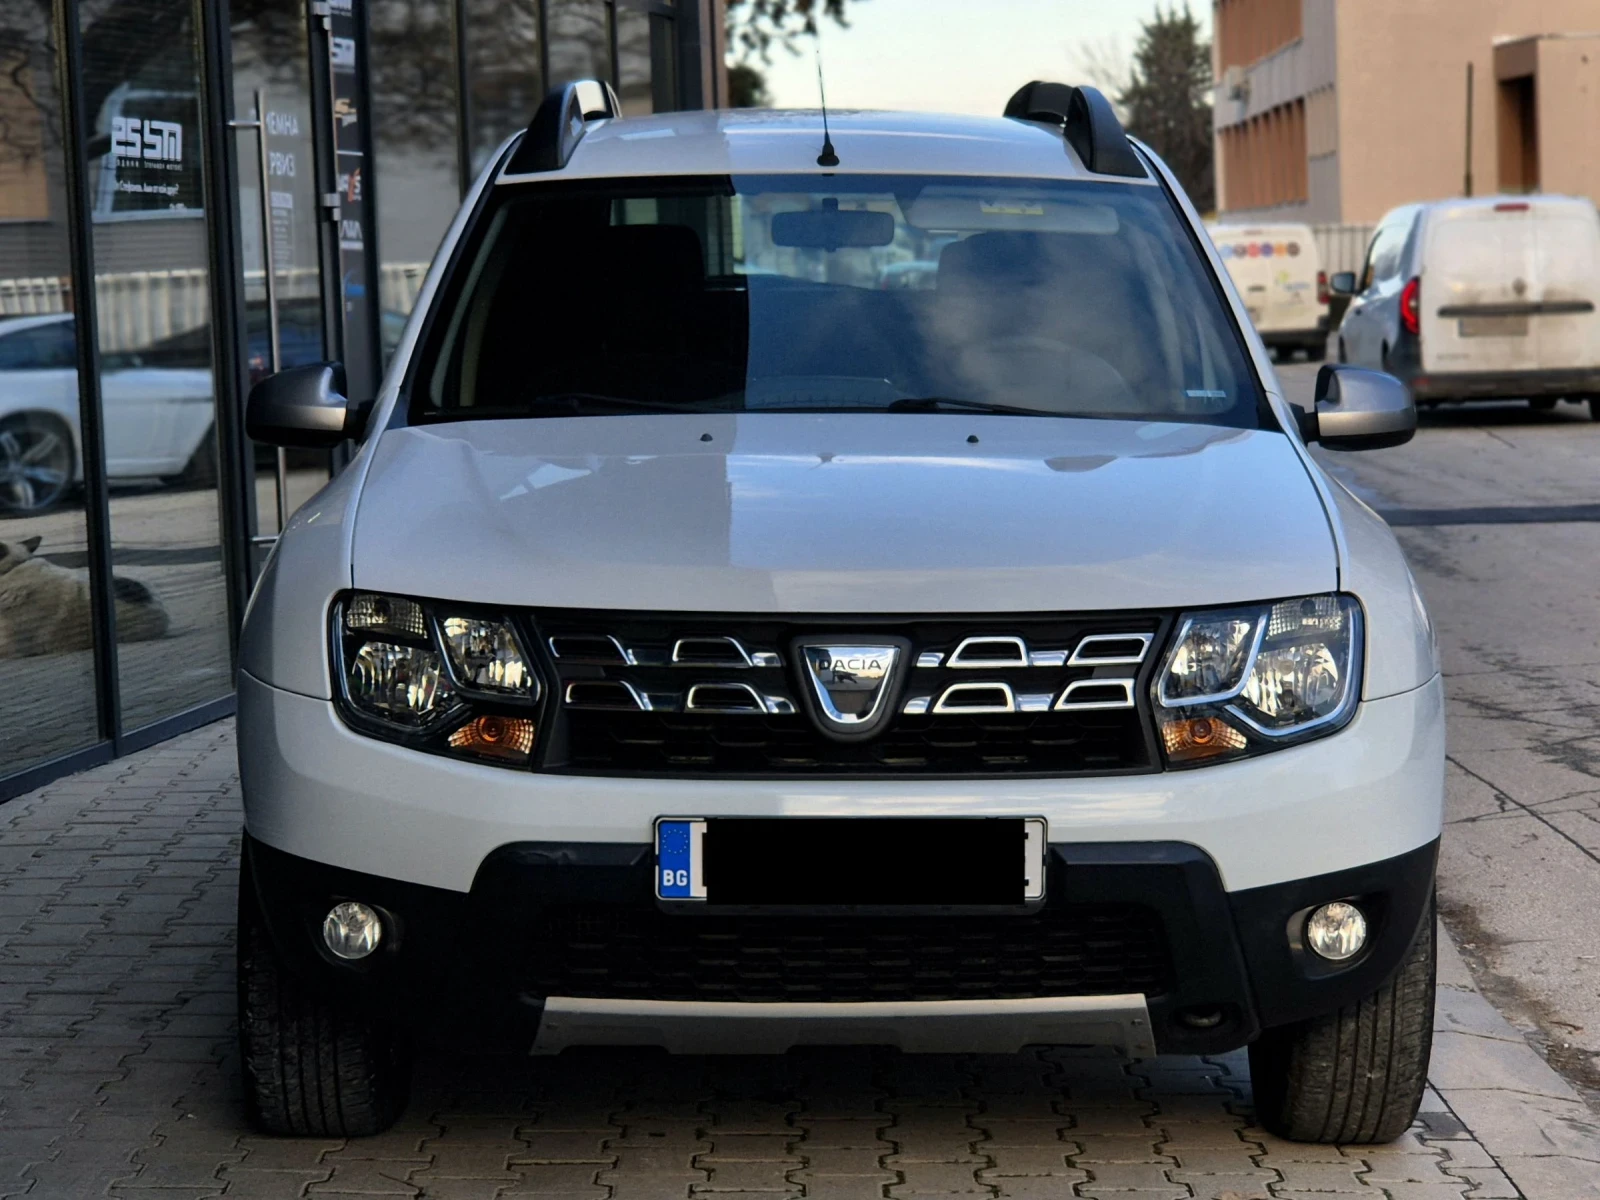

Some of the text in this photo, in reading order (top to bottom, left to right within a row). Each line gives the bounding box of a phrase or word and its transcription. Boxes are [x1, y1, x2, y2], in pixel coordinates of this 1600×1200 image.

[269, 151, 296, 177] РВИЗ
[818, 659, 882, 671] DACIA
[663, 869, 688, 887] BG
